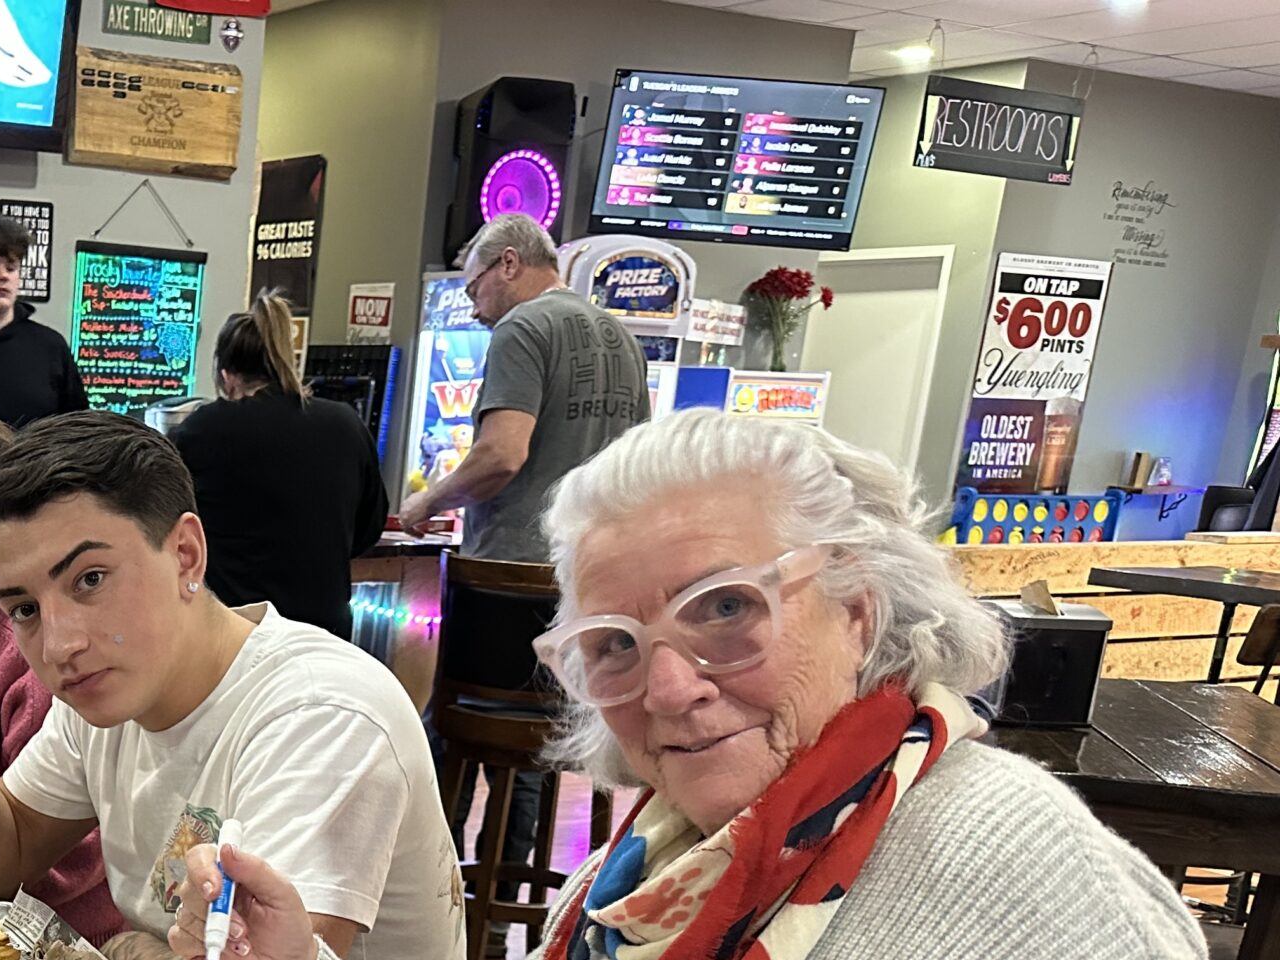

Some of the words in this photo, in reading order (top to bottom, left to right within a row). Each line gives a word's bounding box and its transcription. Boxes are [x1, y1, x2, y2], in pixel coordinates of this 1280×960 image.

[107, 4, 130, 31] AXE
[133, 7, 194, 38] THROWING
[195, 15, 208, 27] DR
[931, 95, 1064, 161] RESTROOMS
[129, 135, 186, 150] CHAMPION
[36, 230, 49, 245] TO
[257, 222, 286, 240] GREAT
[287, 220, 315, 239] TASTE
[257, 244, 270, 260] 96
[270, 241, 312, 259] CALORIES
[605, 267, 663, 287] PRIZE
[1023, 276, 1048, 294] ON
[1050, 278, 1080, 295] TAP
[614, 284, 669, 299] FACTORY
[354, 297, 389, 317] NOW
[1039, 338, 1085, 354] PINTS
[973, 347, 1091, 398] Yuengling
[980, 414, 1033, 440] OLDEST
[968, 442, 1035, 466] BREWERY
[972, 468, 984, 479] IN
[985, 468, 1022, 479] AMERICA
